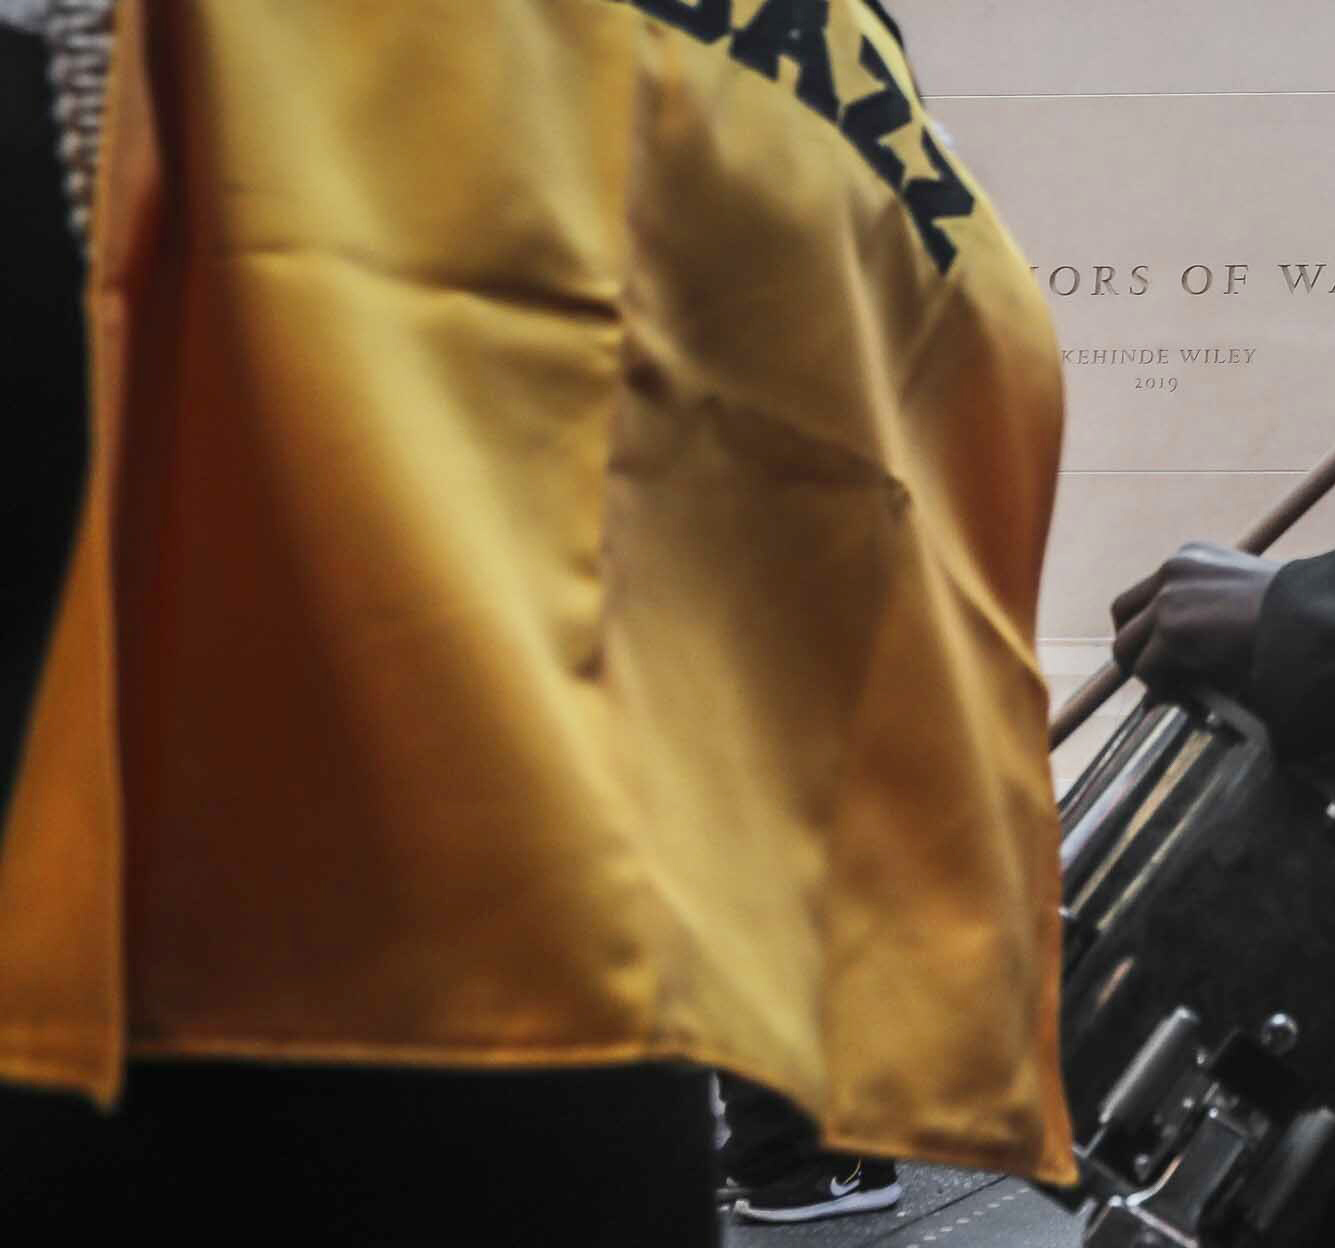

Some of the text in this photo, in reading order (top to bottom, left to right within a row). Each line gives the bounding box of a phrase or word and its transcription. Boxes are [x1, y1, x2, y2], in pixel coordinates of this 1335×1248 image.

[1030, 265, 1150, 296] ORS
[1181, 264, 1250, 296] OF
[1060, 347, 1257, 366] KEHINDE WILEY
[1134, 376, 1179, 393] 2019
